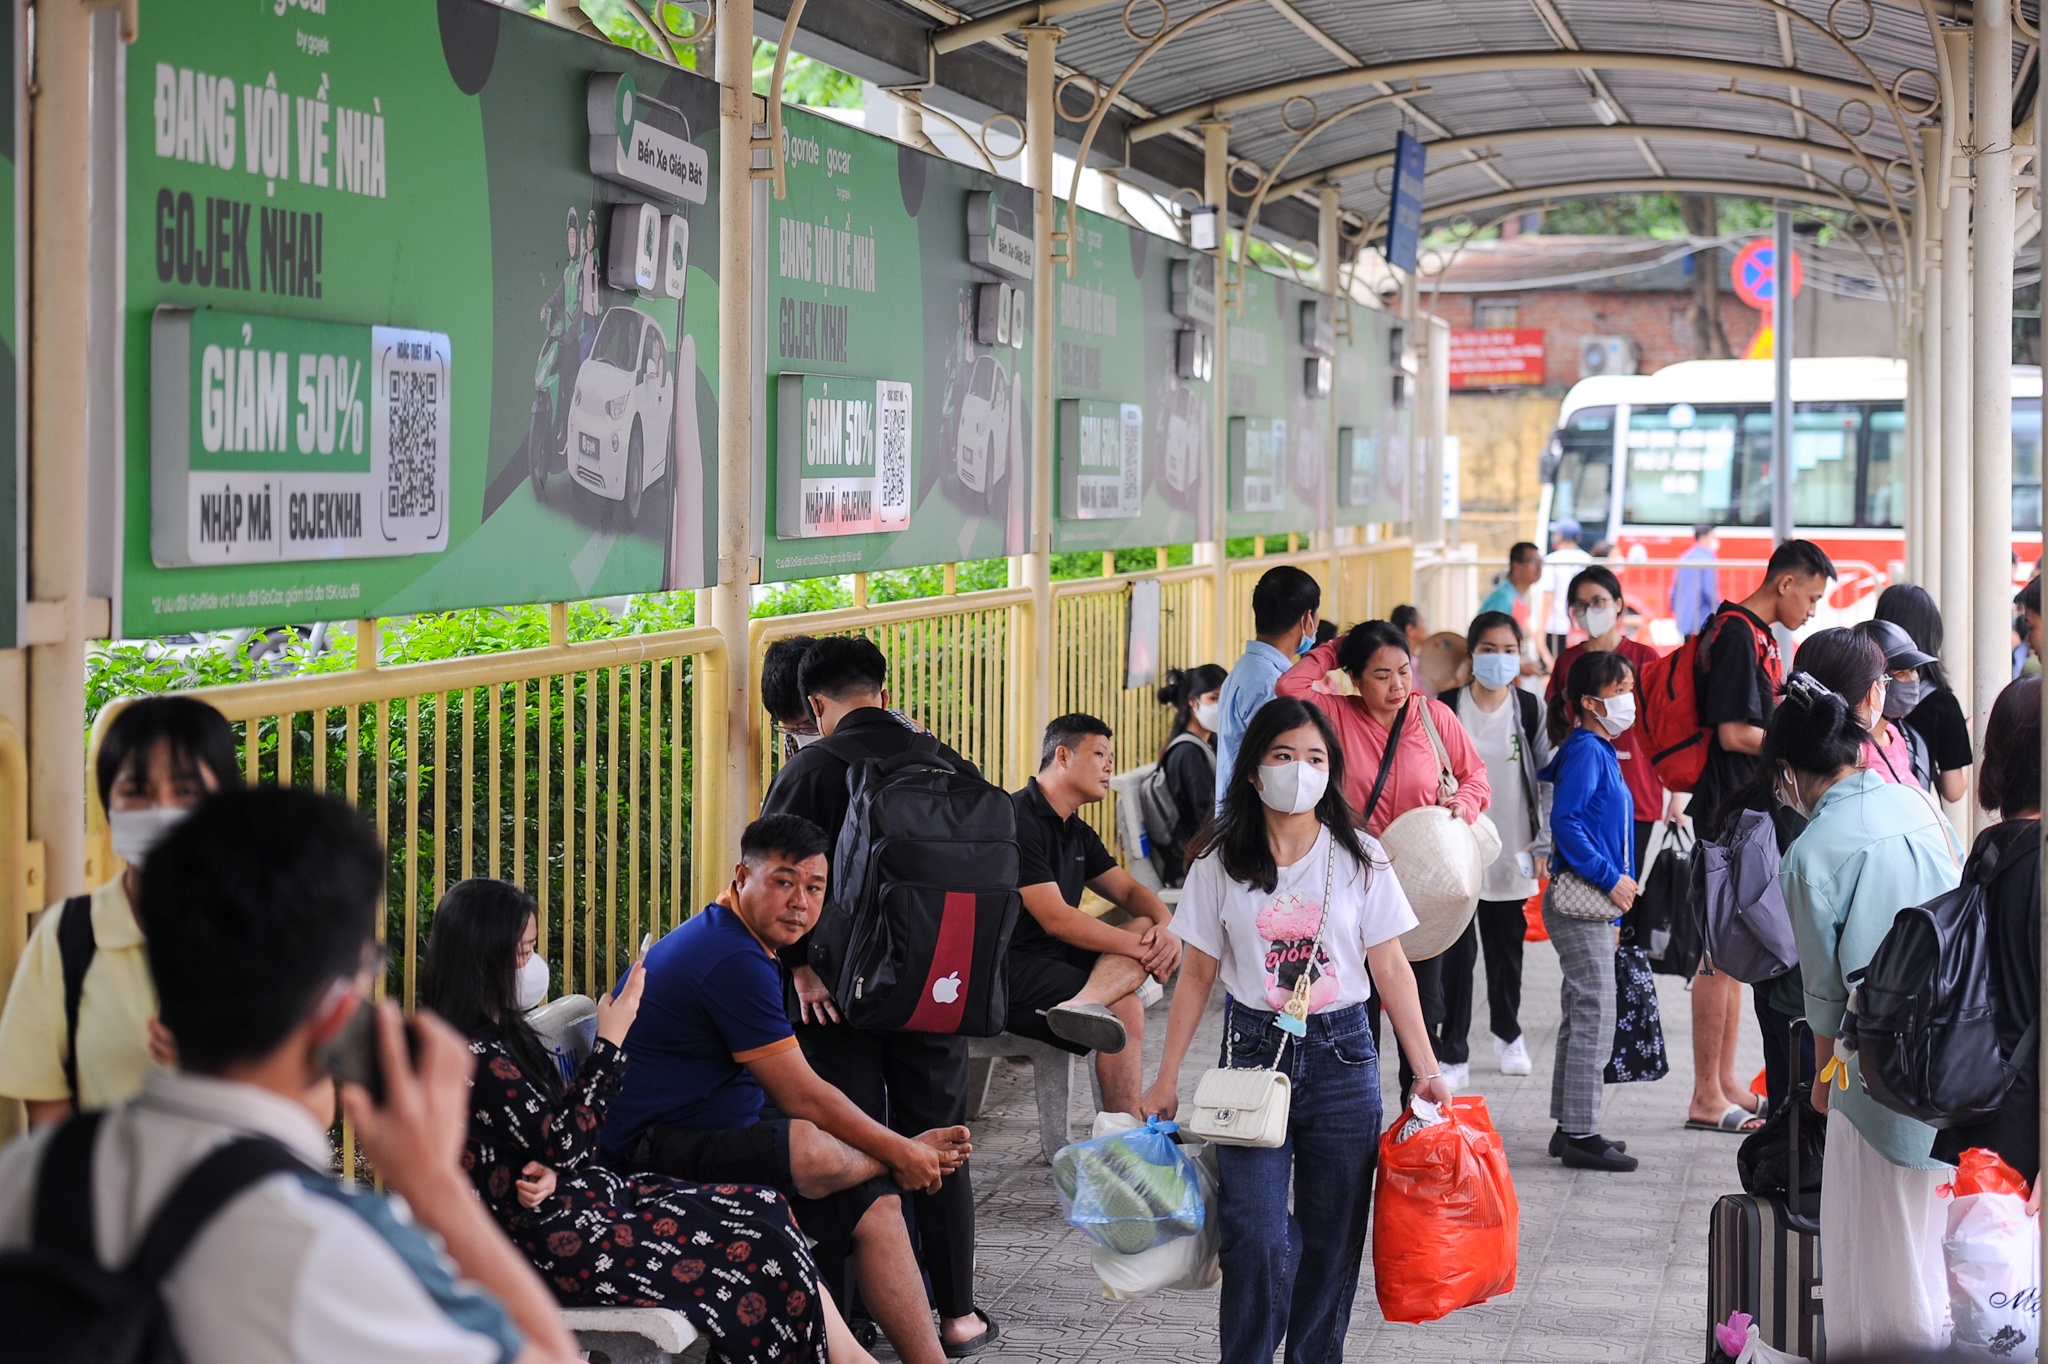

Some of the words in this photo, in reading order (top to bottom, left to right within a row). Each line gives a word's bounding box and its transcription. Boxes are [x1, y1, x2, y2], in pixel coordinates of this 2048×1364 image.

[154, 62, 236, 171] ĐANG
[243, 71, 290, 197] VỘI
[296, 72, 330, 188] VỀ
[336, 97, 386, 199] NHÀ
[637, 138, 655, 167] Bến
[656, 147, 668, 172] Xe
[668, 153, 687, 185] Giáp
[688, 161, 703, 186] Bát
[827, 147, 851, 178] gocar
[156, 187, 251, 292] GOJEK
[260, 206, 323, 299] NHA!
[779, 217, 812, 282] ĐANG
[815, 215, 834, 297] VỘI
[836, 213, 851, 289] VỀ
[853, 225, 876, 293] NHÀ
[779, 296, 818, 359] GOJEK
[821, 304, 848, 363] NHA!
[201, 322, 288, 453] GIẢM
[296, 353, 364, 455] 50%
[807, 382, 842, 466] GIẢM
[845, 400, 873, 466] 50%
[200, 484, 243, 554] NHẬP
[247, 484, 272, 542] MÃ
[289, 493, 362, 541] GOJEKNHA
[805, 486, 823, 530] NHẬP
[824, 486, 835, 524] MÃ
[841, 490, 872, 523] GOJEKNHA
